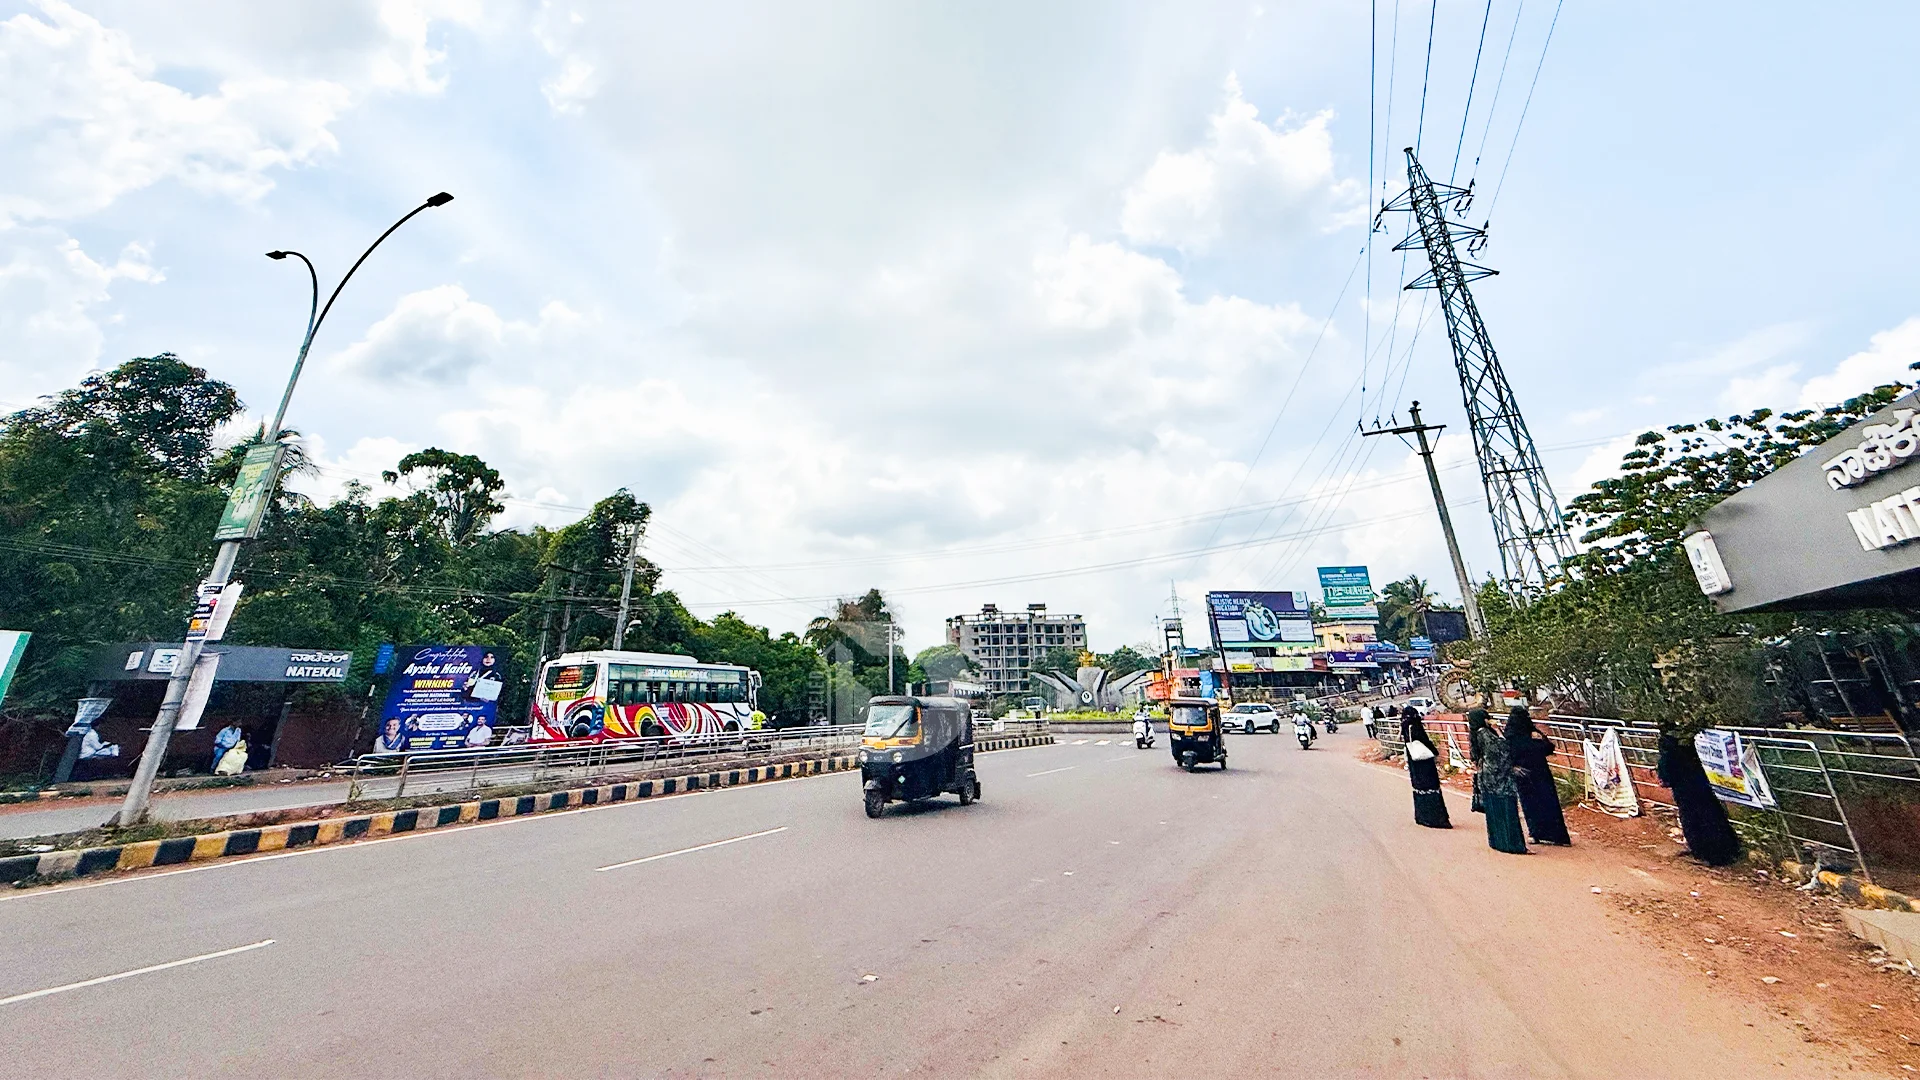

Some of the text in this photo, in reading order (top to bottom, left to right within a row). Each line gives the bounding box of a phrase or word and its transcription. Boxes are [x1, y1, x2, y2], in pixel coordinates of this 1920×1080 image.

[285, 666, 344, 678] NATEKAL
[403, 662, 440, 676] Aysha
[414, 679, 454, 688] WINNING
